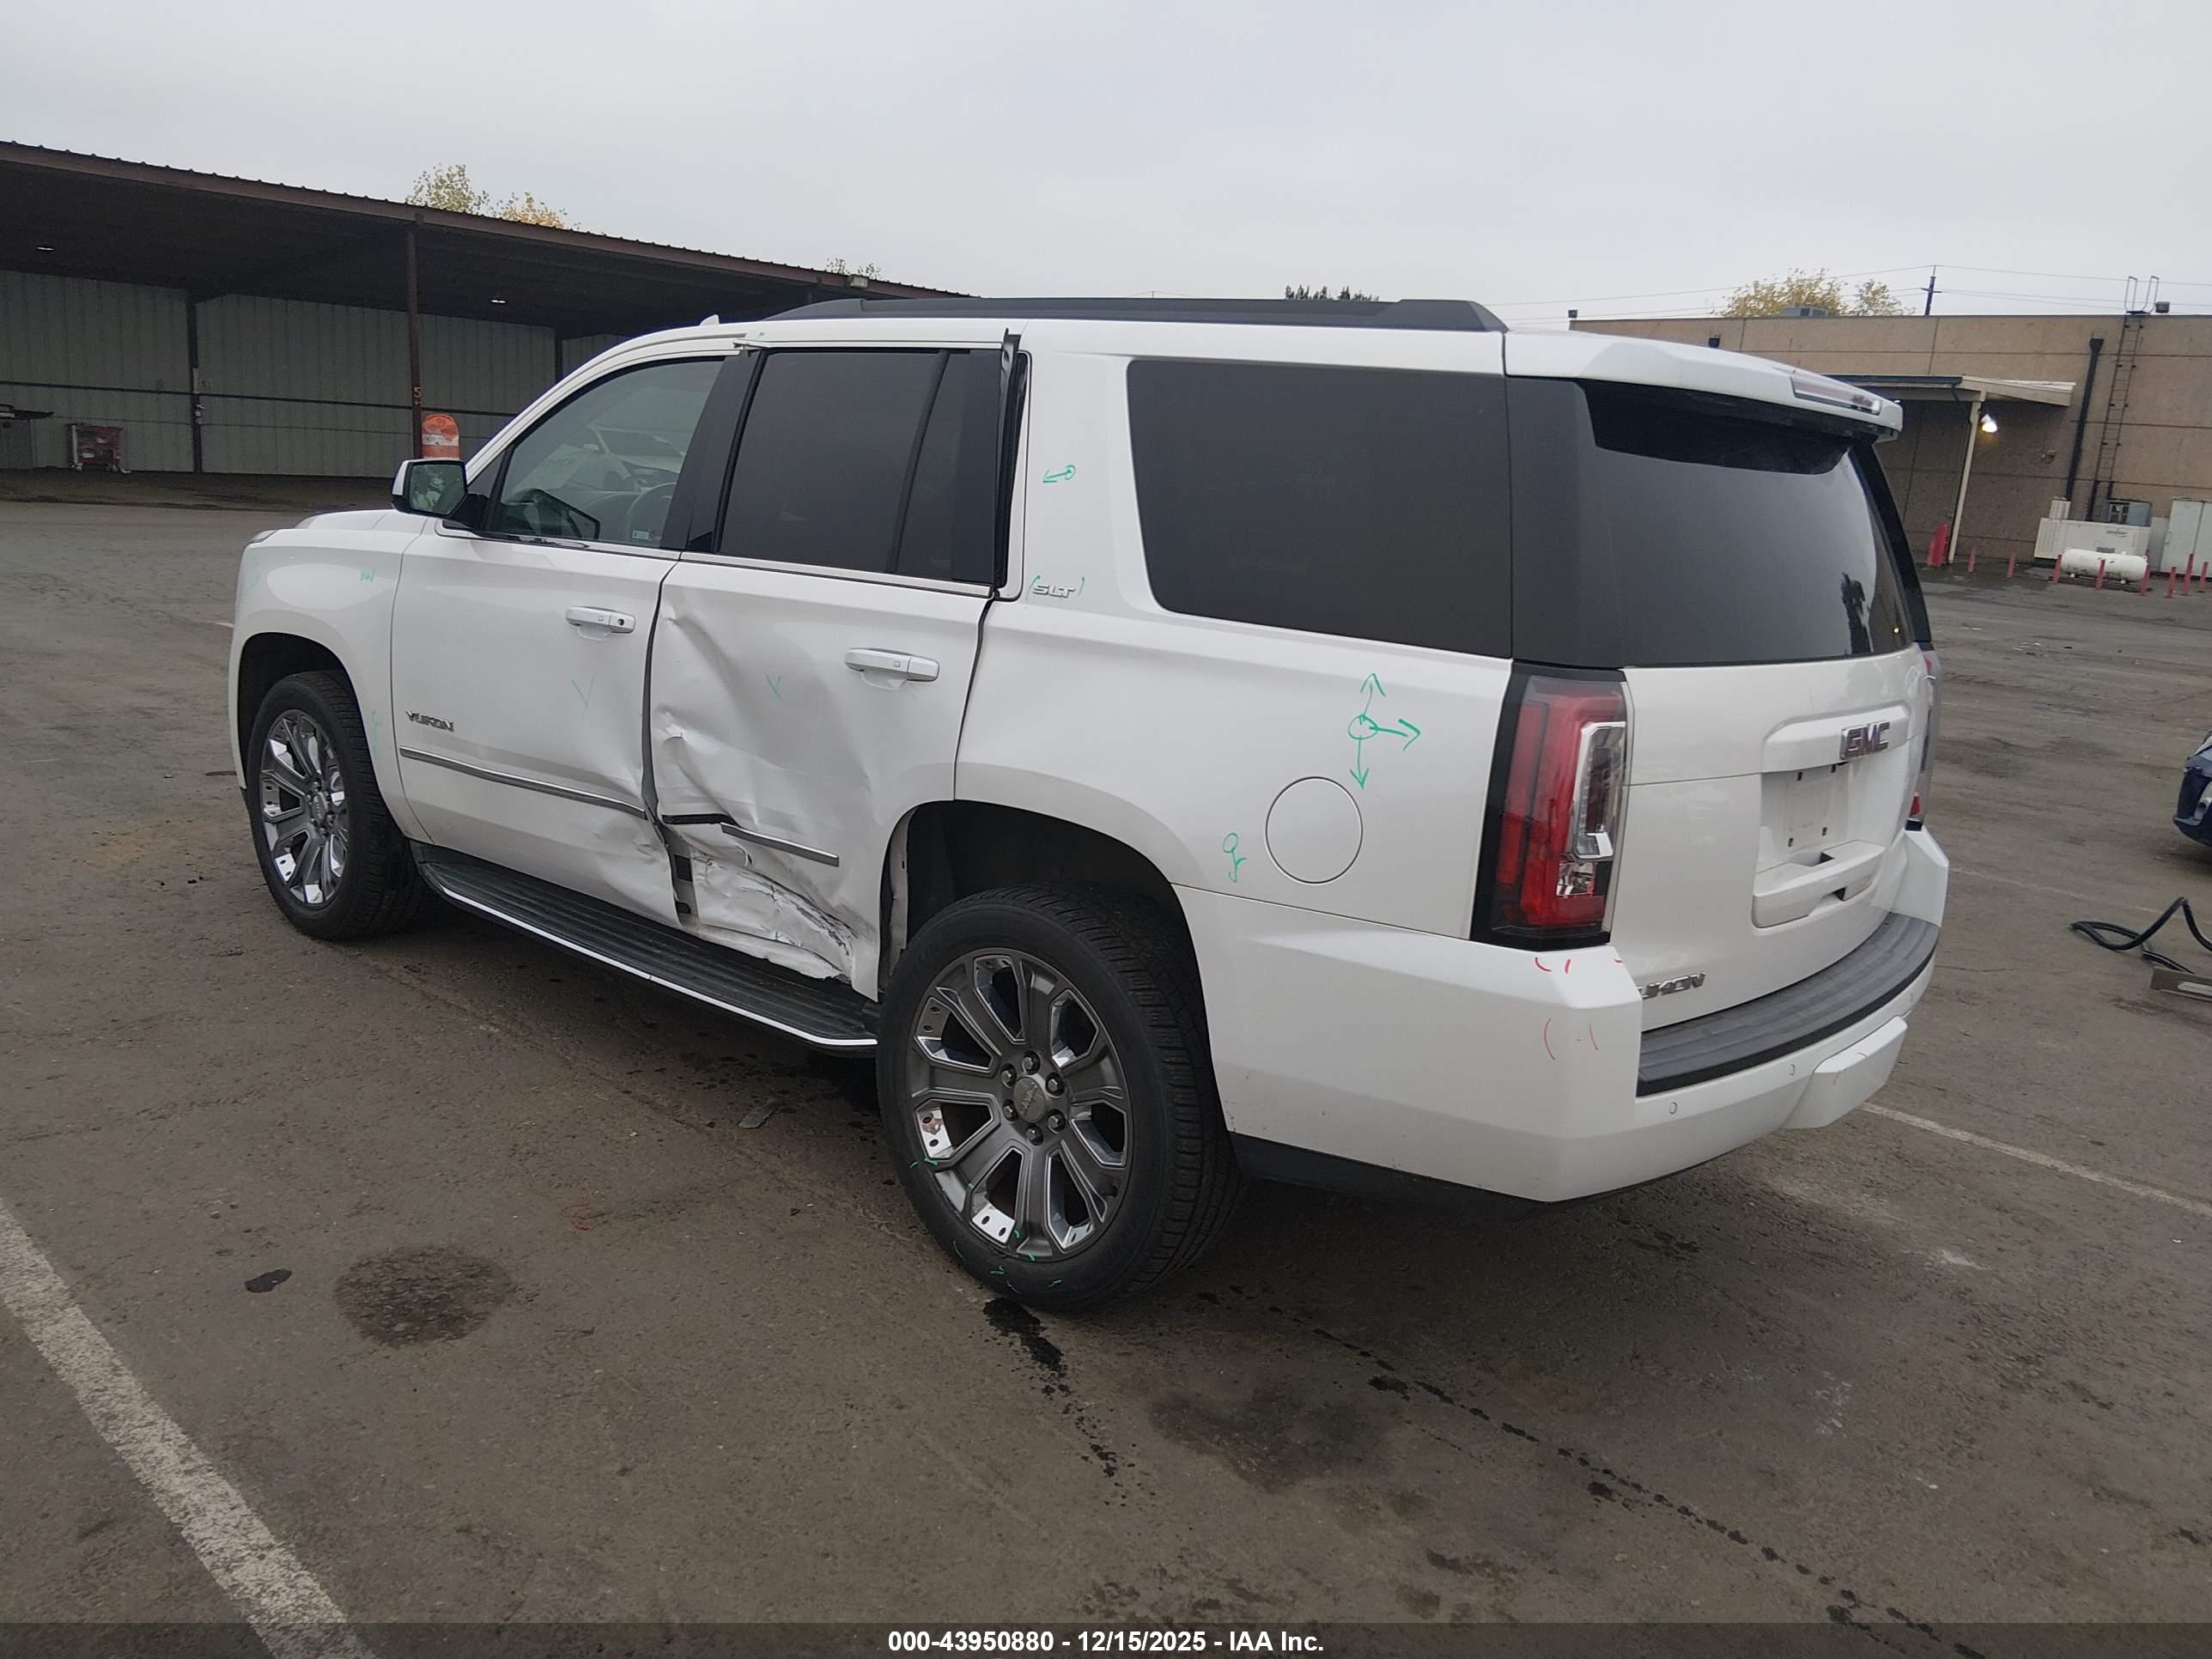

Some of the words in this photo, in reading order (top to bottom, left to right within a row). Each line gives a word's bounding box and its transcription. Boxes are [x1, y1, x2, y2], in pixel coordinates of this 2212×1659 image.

[1032, 585, 1076, 599] SLT
[404, 710, 454, 732] YUKON
[1840, 721, 1890, 760] GMC
